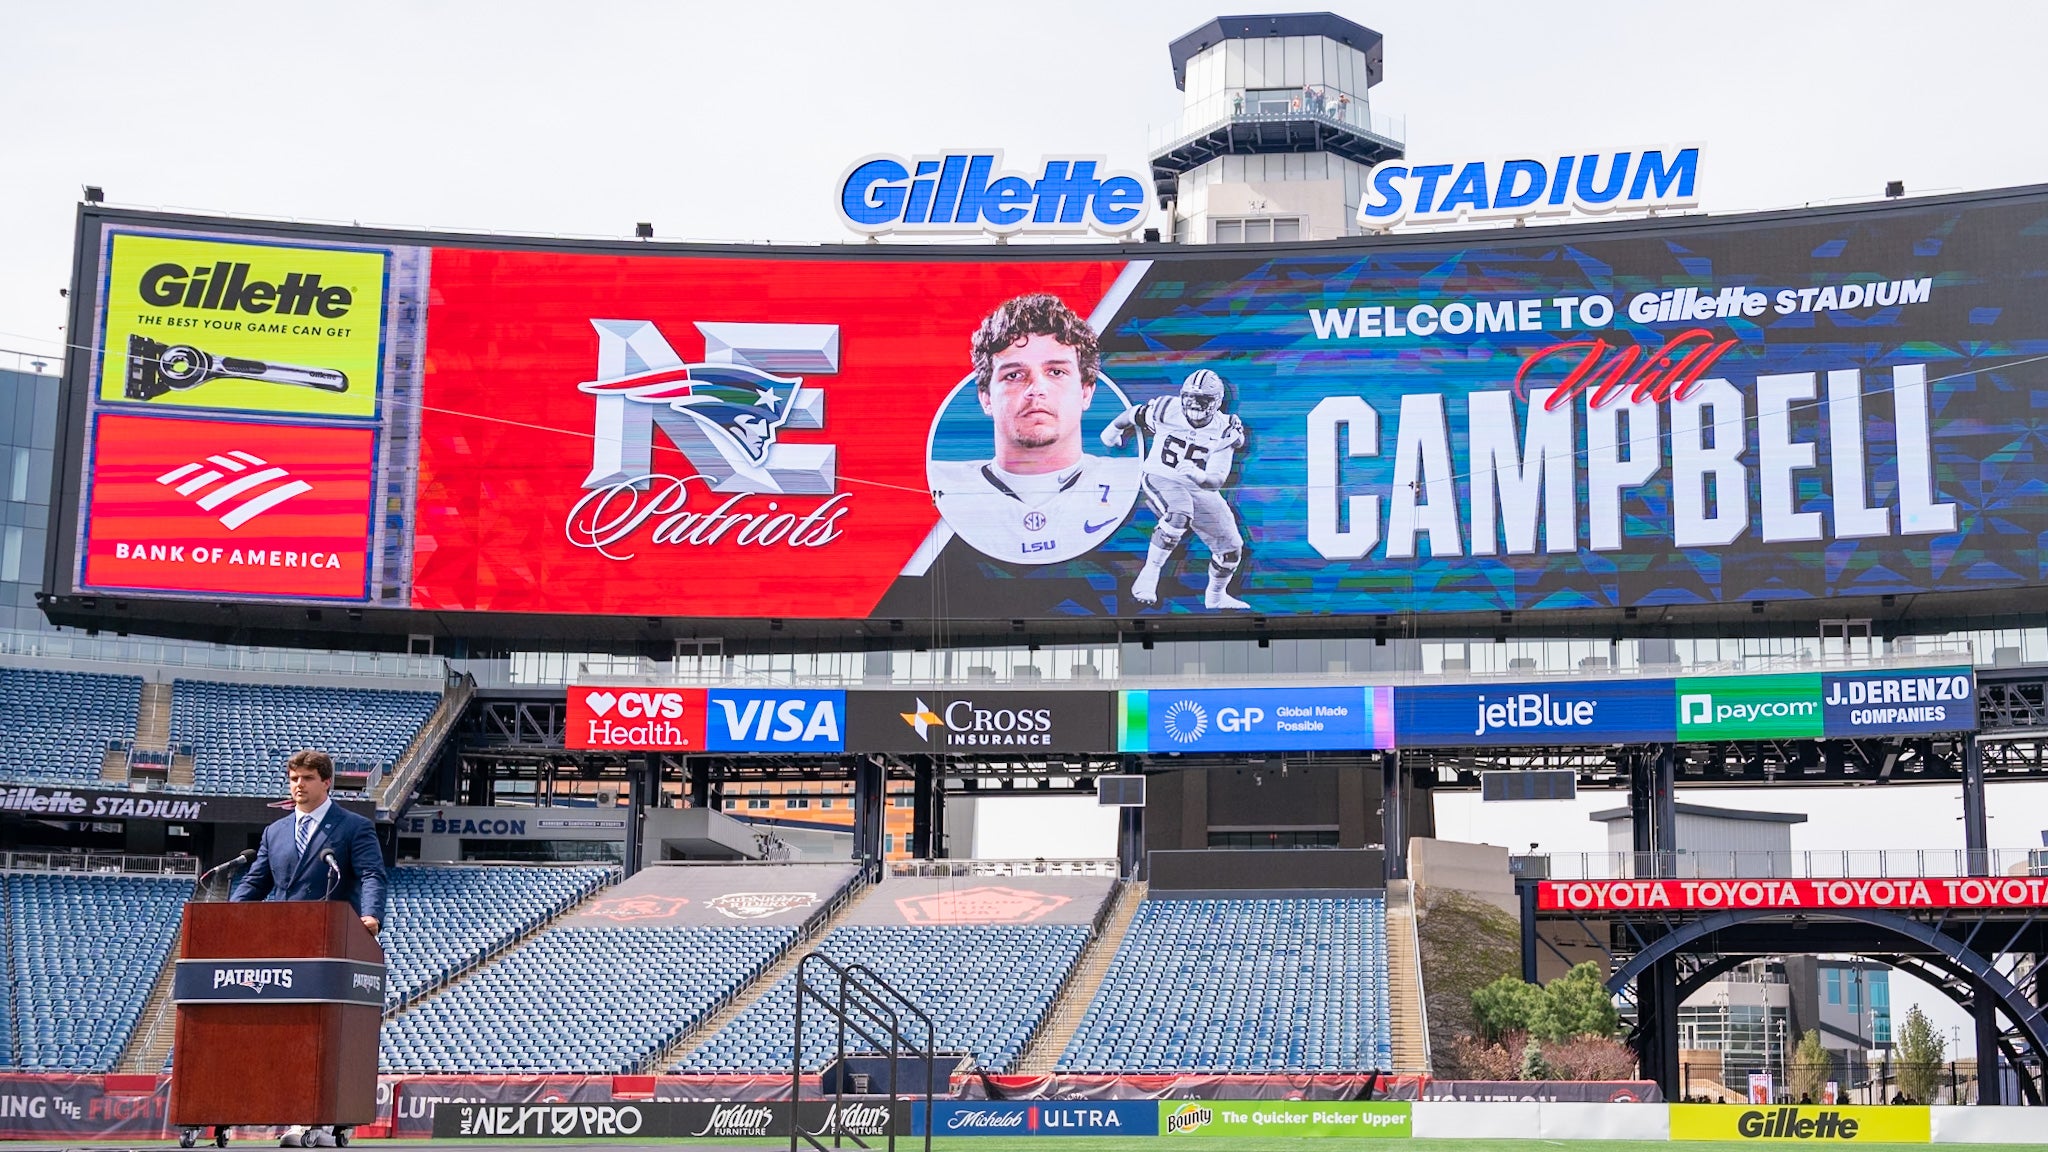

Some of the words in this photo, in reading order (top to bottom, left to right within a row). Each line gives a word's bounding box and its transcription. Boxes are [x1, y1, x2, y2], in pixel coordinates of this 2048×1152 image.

[841, 154, 1143, 226] Gillette
[1363, 147, 1701, 217] STADIUM
[139, 261, 352, 319] Gillette
[1309, 301, 1543, 339] WELCOME
[1553, 296, 1614, 329] TO
[1627, 287, 1767, 323] Gillette
[1774, 278, 1933, 315] STADIUM
[137, 315, 162, 326] THE
[167, 317, 198, 328] BEST
[203, 319, 242, 331] YOUR
[247, 323, 287, 334] GAME
[292, 325, 321, 337] CAN
[326, 327, 351, 337] GET
[1514, 329, 1738, 413] Will
[1306, 363, 1958, 560] CAMPBELL
[565, 474, 853, 560] Patriots
[116, 543, 184, 562] BANK
[191, 547, 223, 563] OF
[229, 549, 341, 568] AMERICA
[1021, 540, 1056, 554] LSU
[617, 693, 683, 719] CVS
[1276, 706, 1312, 717] Global
[1315, 706, 1348, 717] Made
[1475, 693, 1593, 735] jetBlue
[1717, 701, 1813, 723] paycom
[1850, 706, 1946, 725] COMPANIES
[712, 700, 839, 742] VISA
[1277, 721, 1324, 731] Possible
[948, 734, 1051, 745] INSURANCE
[92, 797, 200, 820] STADIUM
[432, 819, 526, 835] BEACON
[1551, 882, 1671, 907] TOYOTA
[1681, 881, 1801, 906] TOYOTA
[1812, 880, 1932, 905] TOYOTA
[1943, 879, 2048, 904] TOYOT
[213, 968, 293, 990] PATRIOTS
[352, 973, 381, 990] PATRIOTS
[52, 1097, 81, 1120] THE
[691, 1103, 774, 1137] Jordan's
[947, 1110, 1025, 1130] Michelob
[1044, 1109, 1121, 1128] ULTRA
[1167, 1107, 1213, 1133] Bounty
[1221, 1111, 1248, 1124] The
[1252, 1111, 1309, 1125] Quicker
[1312, 1111, 1359, 1124] Picker
[1362, 1112, 1407, 1128] Upper
[460, 1107, 472, 1135] MLS
[714, 1127, 767, 1136] FURNITURE
[1738, 1107, 1859, 1139] Gillette
